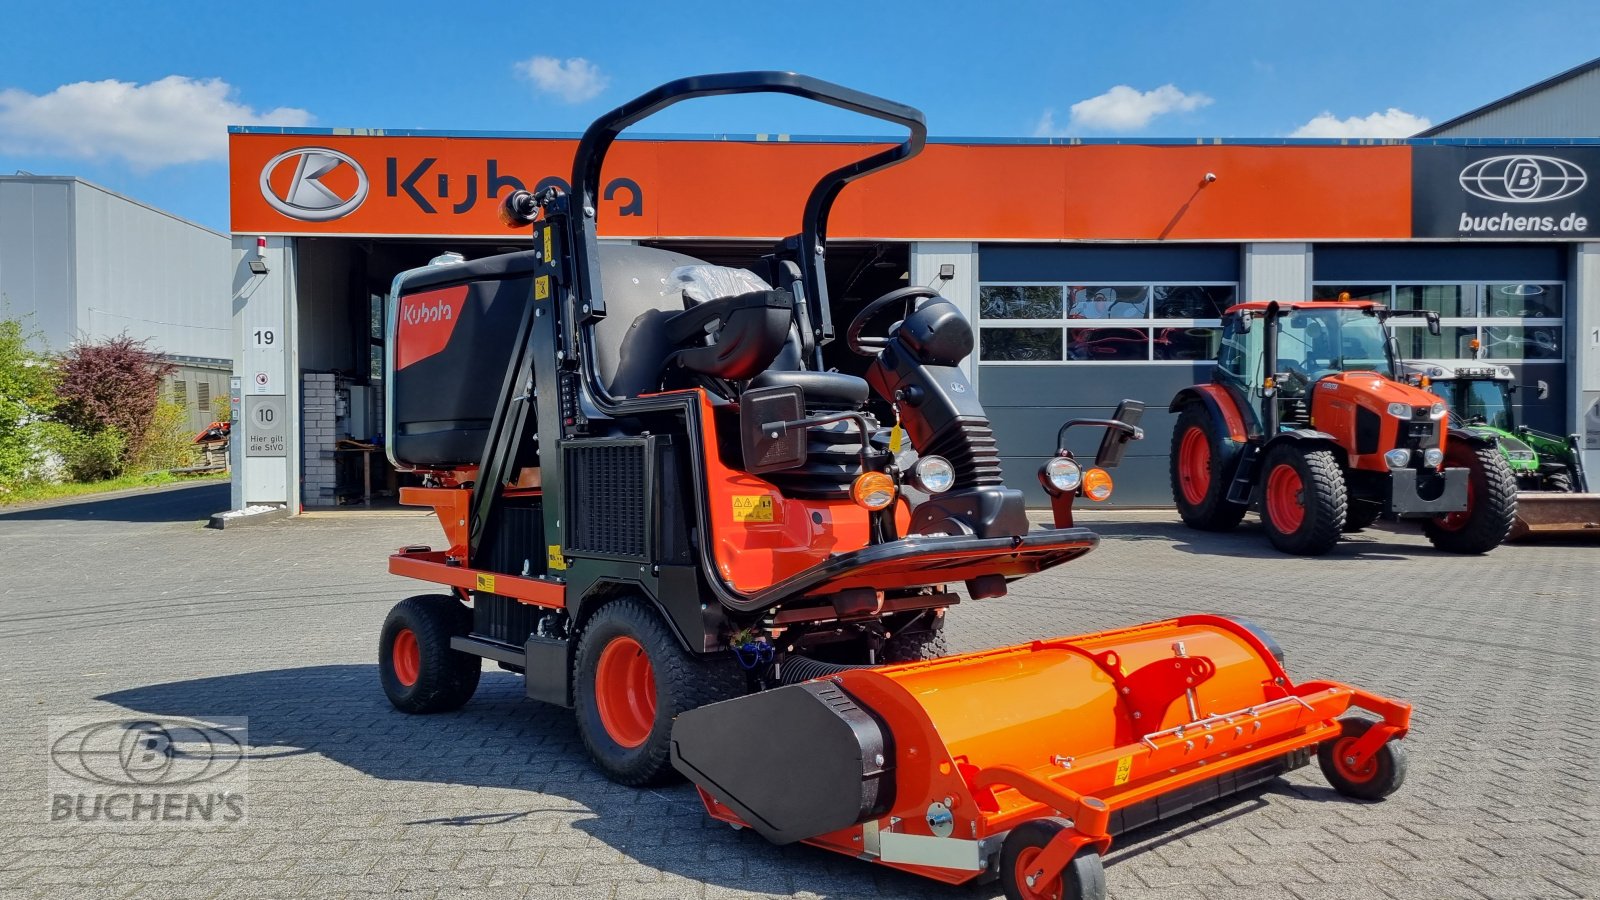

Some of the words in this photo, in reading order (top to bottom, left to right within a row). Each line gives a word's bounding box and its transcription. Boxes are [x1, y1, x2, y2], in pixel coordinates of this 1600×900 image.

[386, 156, 643, 217] Kuba
[1459, 212, 1588, 232] buchens.de
[403, 299, 452, 325] Kubota
[254, 330, 274, 345] 19
[259, 408, 274, 422] 10
[250, 435, 267, 443] Hier
[270, 435, 283, 444] gilt
[250, 443, 262, 451] die
[264, 443, 284, 451] StVO
